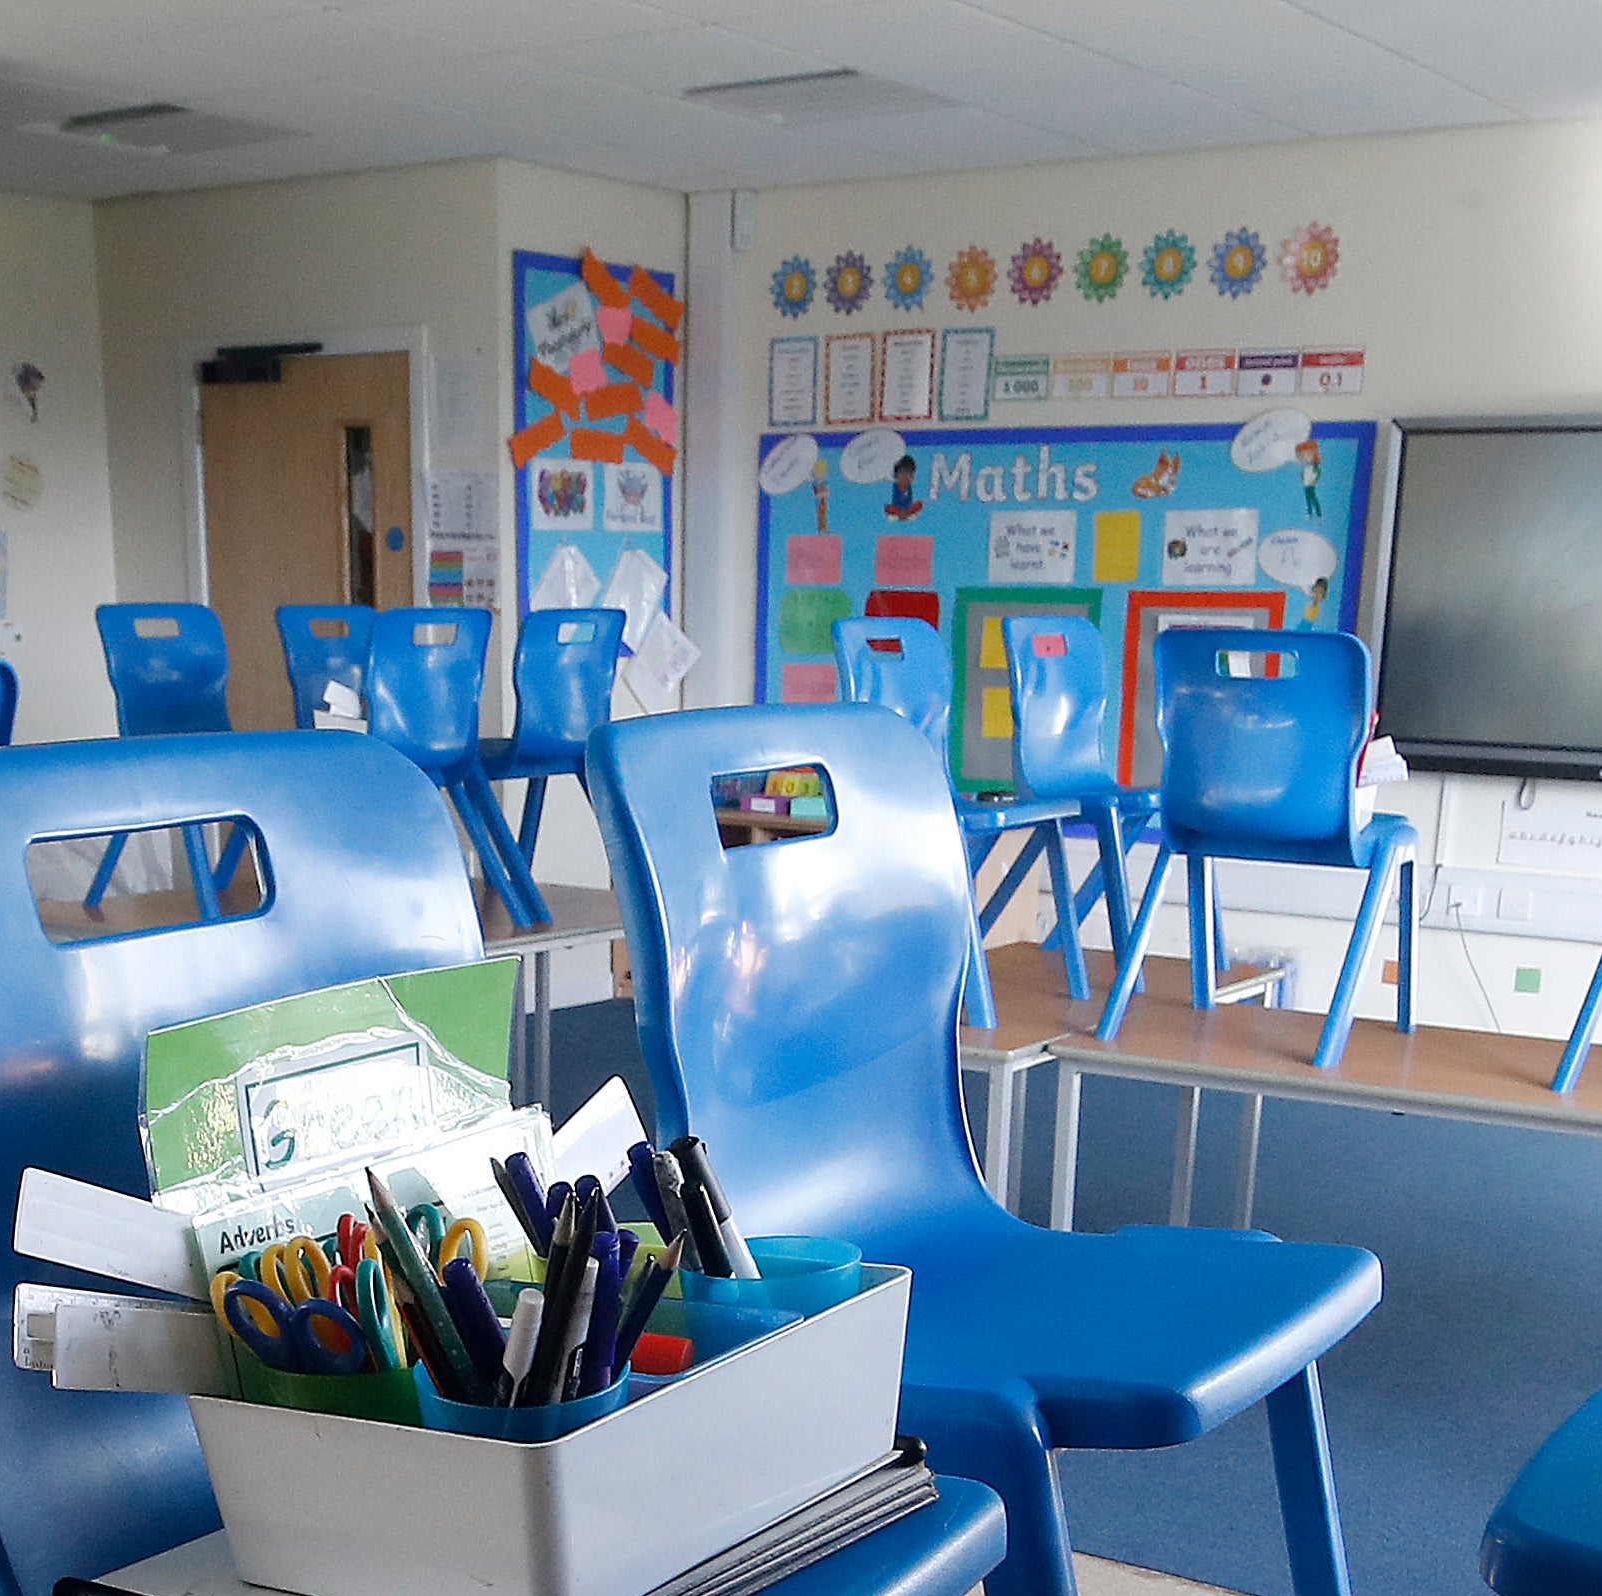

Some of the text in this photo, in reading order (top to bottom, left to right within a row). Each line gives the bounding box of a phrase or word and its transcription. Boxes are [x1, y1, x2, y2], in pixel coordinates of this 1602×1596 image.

[928, 444, 1099, 502] Maths
[1184, 524, 1219, 538] What
[1184, 562, 1233, 577] learning
[219, 1214, 296, 1255] Adverbs
